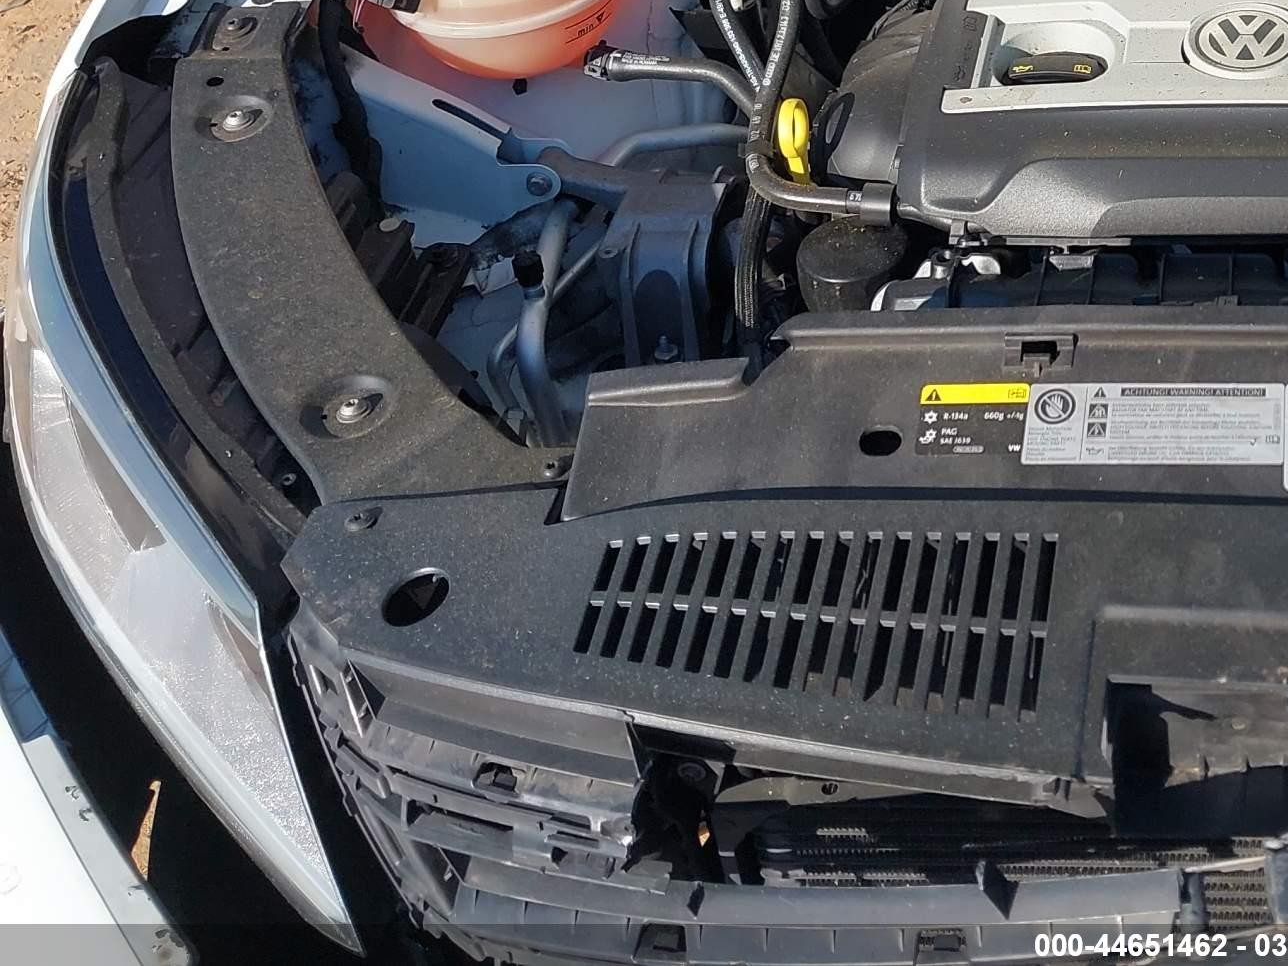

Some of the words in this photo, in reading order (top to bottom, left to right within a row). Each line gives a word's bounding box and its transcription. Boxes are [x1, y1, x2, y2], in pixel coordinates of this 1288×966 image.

[577, 23, 594, 37] min
[1124, 387, 1167, 396] ACHTUNG!
[1169, 387, 1213, 396] WARNING!
[1215, 387, 1263, 396] ATTENTION!
[943, 411, 969, 421] R-134a
[984, 410, 1005, 422] 660g
[941, 427, 958, 436] PAG
[940, 436, 953, 445] SAE
[1008, 444, 1021, 453] VW
